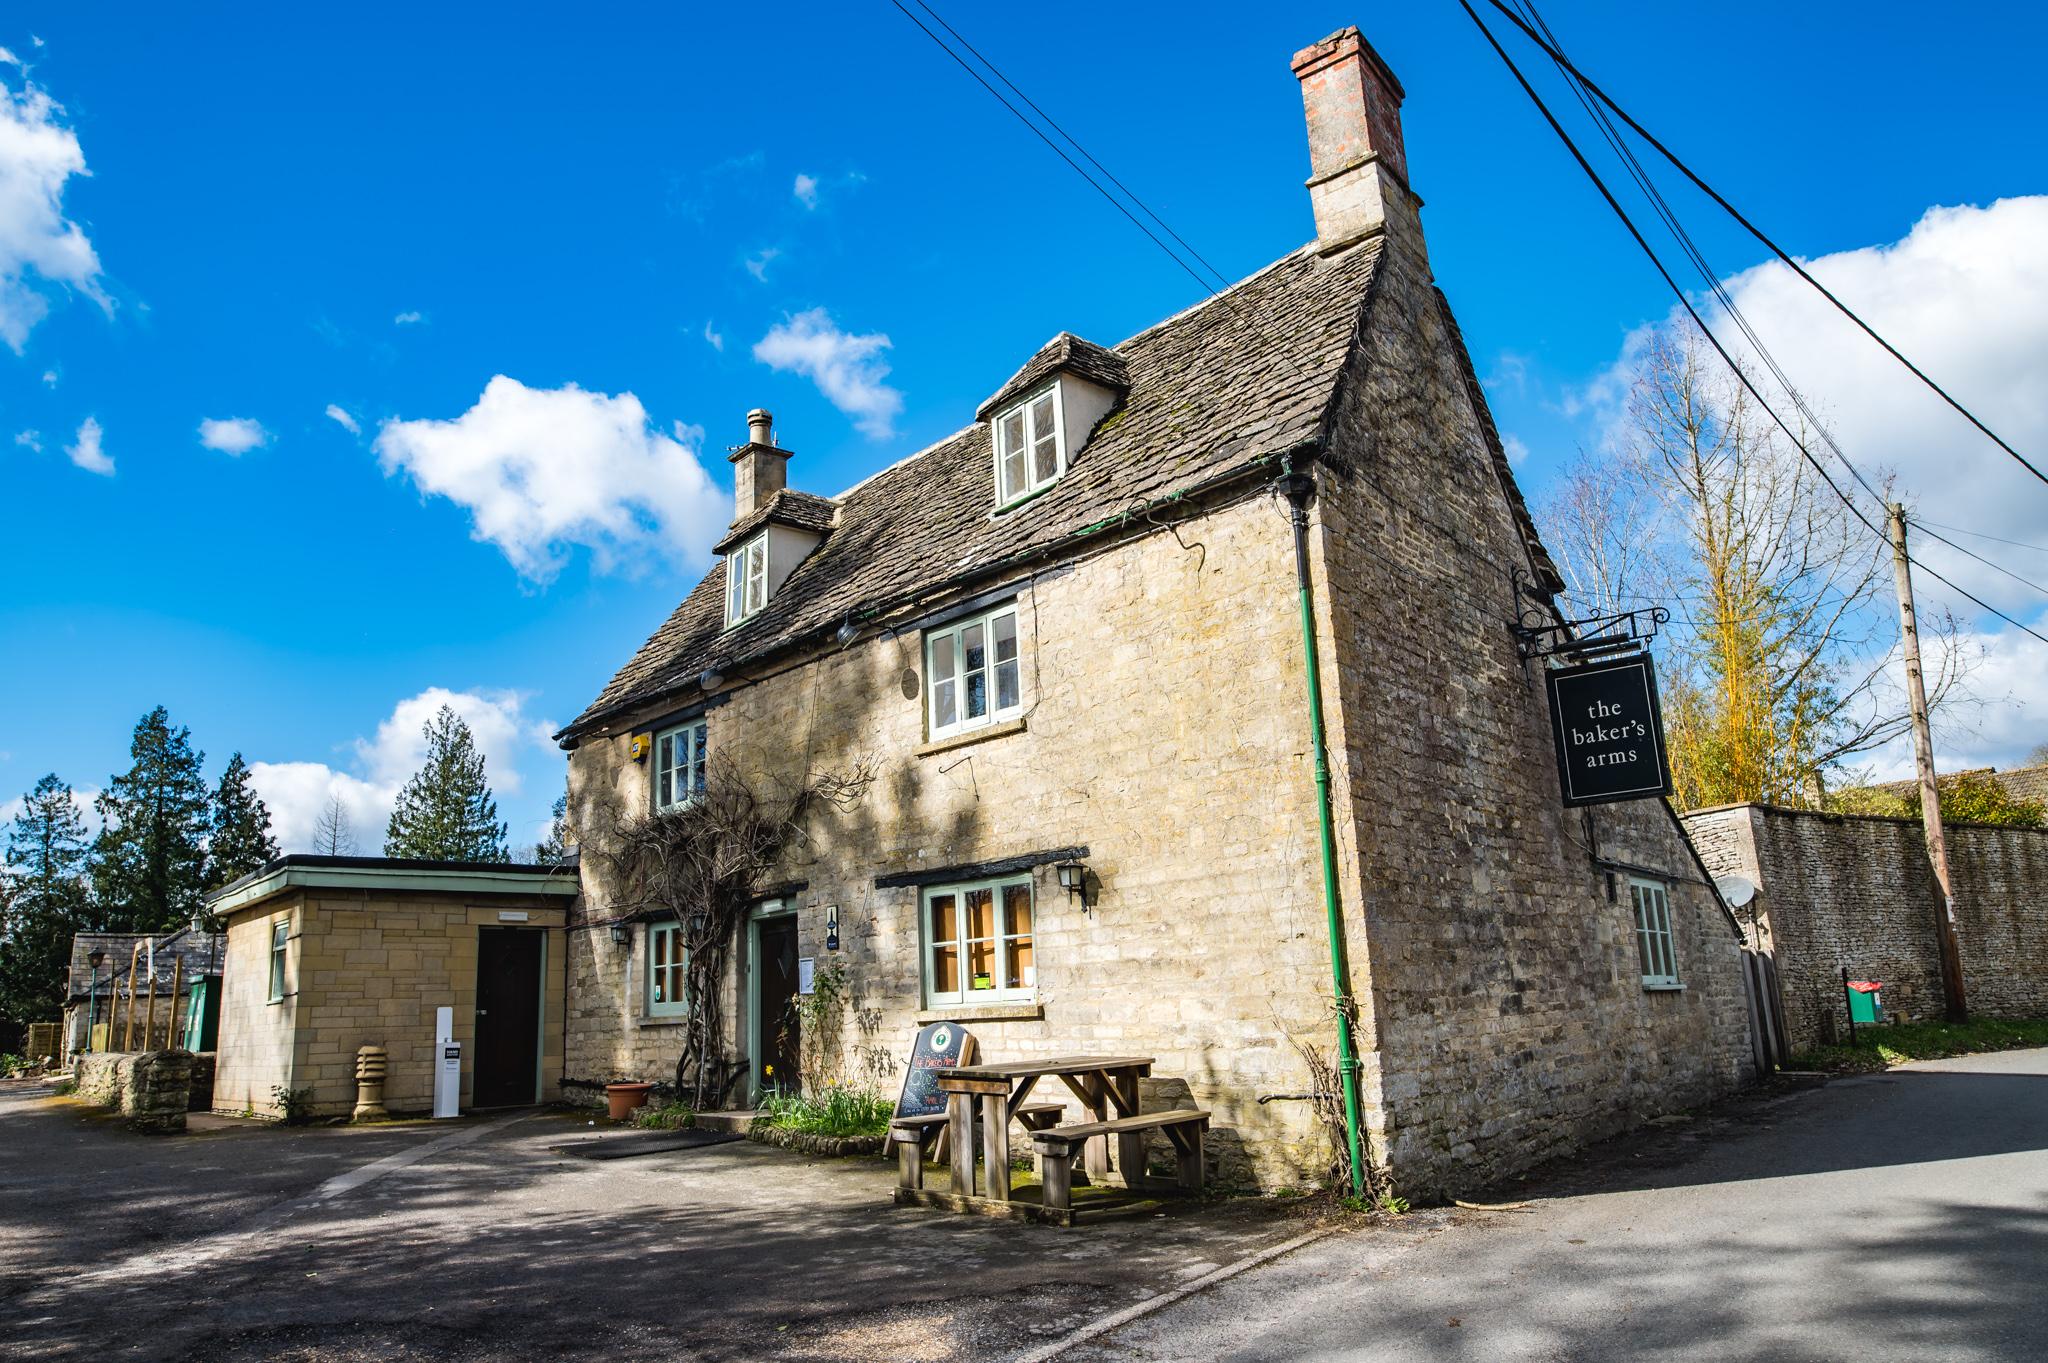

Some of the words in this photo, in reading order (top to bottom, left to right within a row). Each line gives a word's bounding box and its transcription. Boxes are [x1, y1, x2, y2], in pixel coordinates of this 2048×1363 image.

[1588, 700, 1622, 719] the
[1571, 720, 1646, 746] baker's
[1586, 750, 1638, 768] arms
